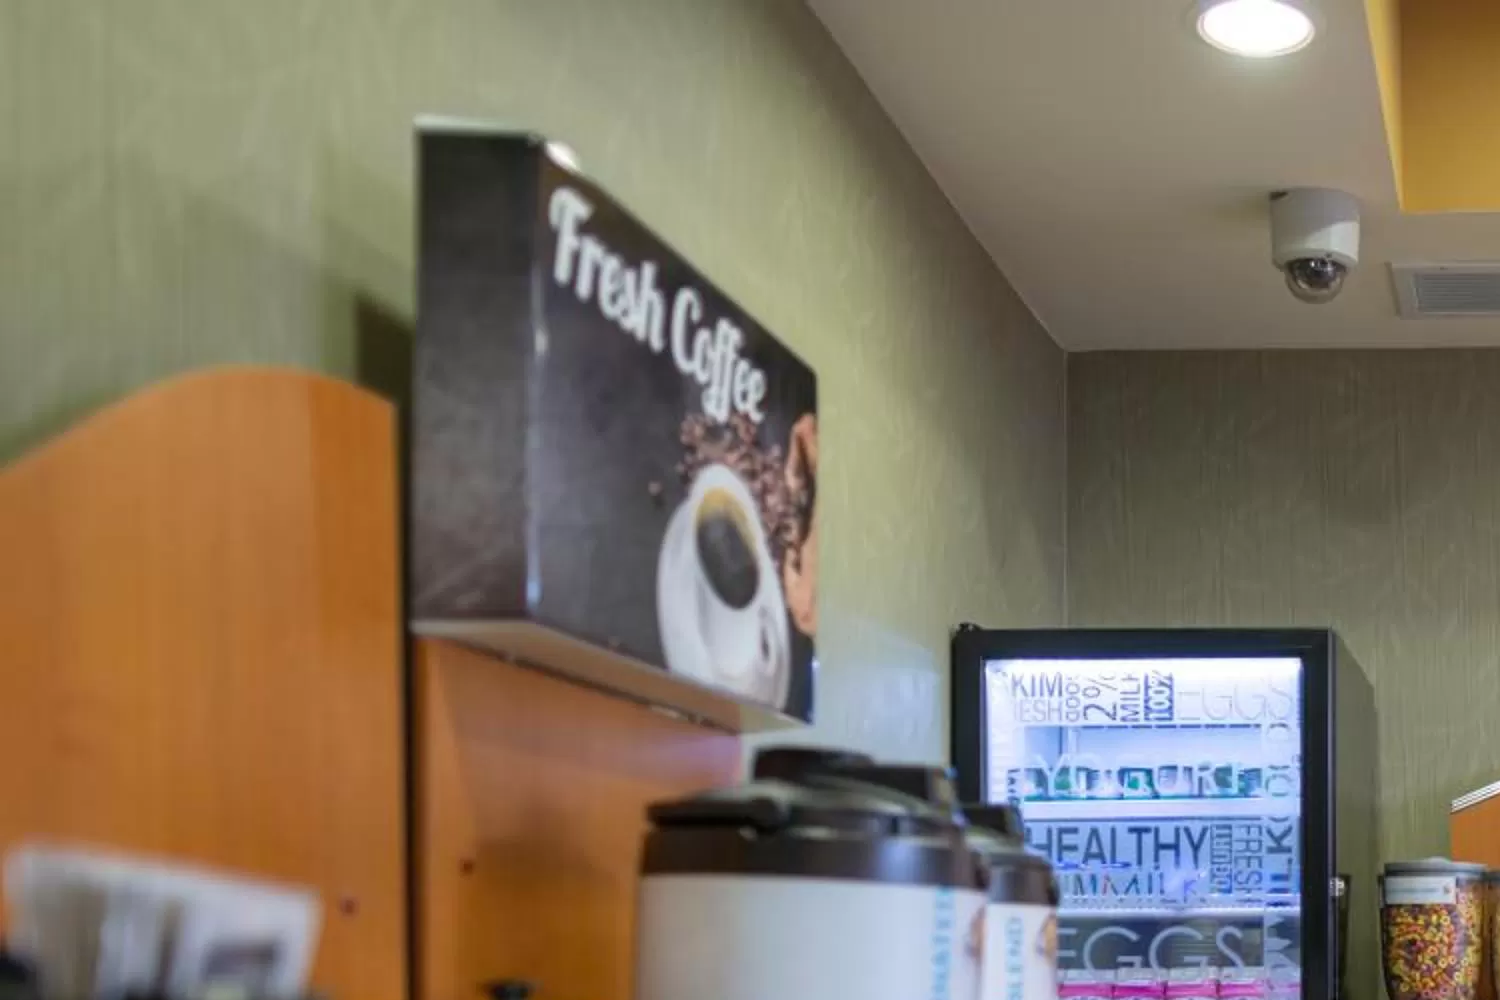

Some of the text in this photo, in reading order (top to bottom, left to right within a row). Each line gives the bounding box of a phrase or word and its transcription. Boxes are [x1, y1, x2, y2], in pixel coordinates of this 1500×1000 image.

[550, 187, 766, 424] Fresh Coffee
[1011, 672, 1063, 698] KIM
[1024, 825, 1210, 867] HEALTHY
[1234, 823, 1263, 903] FRESH
